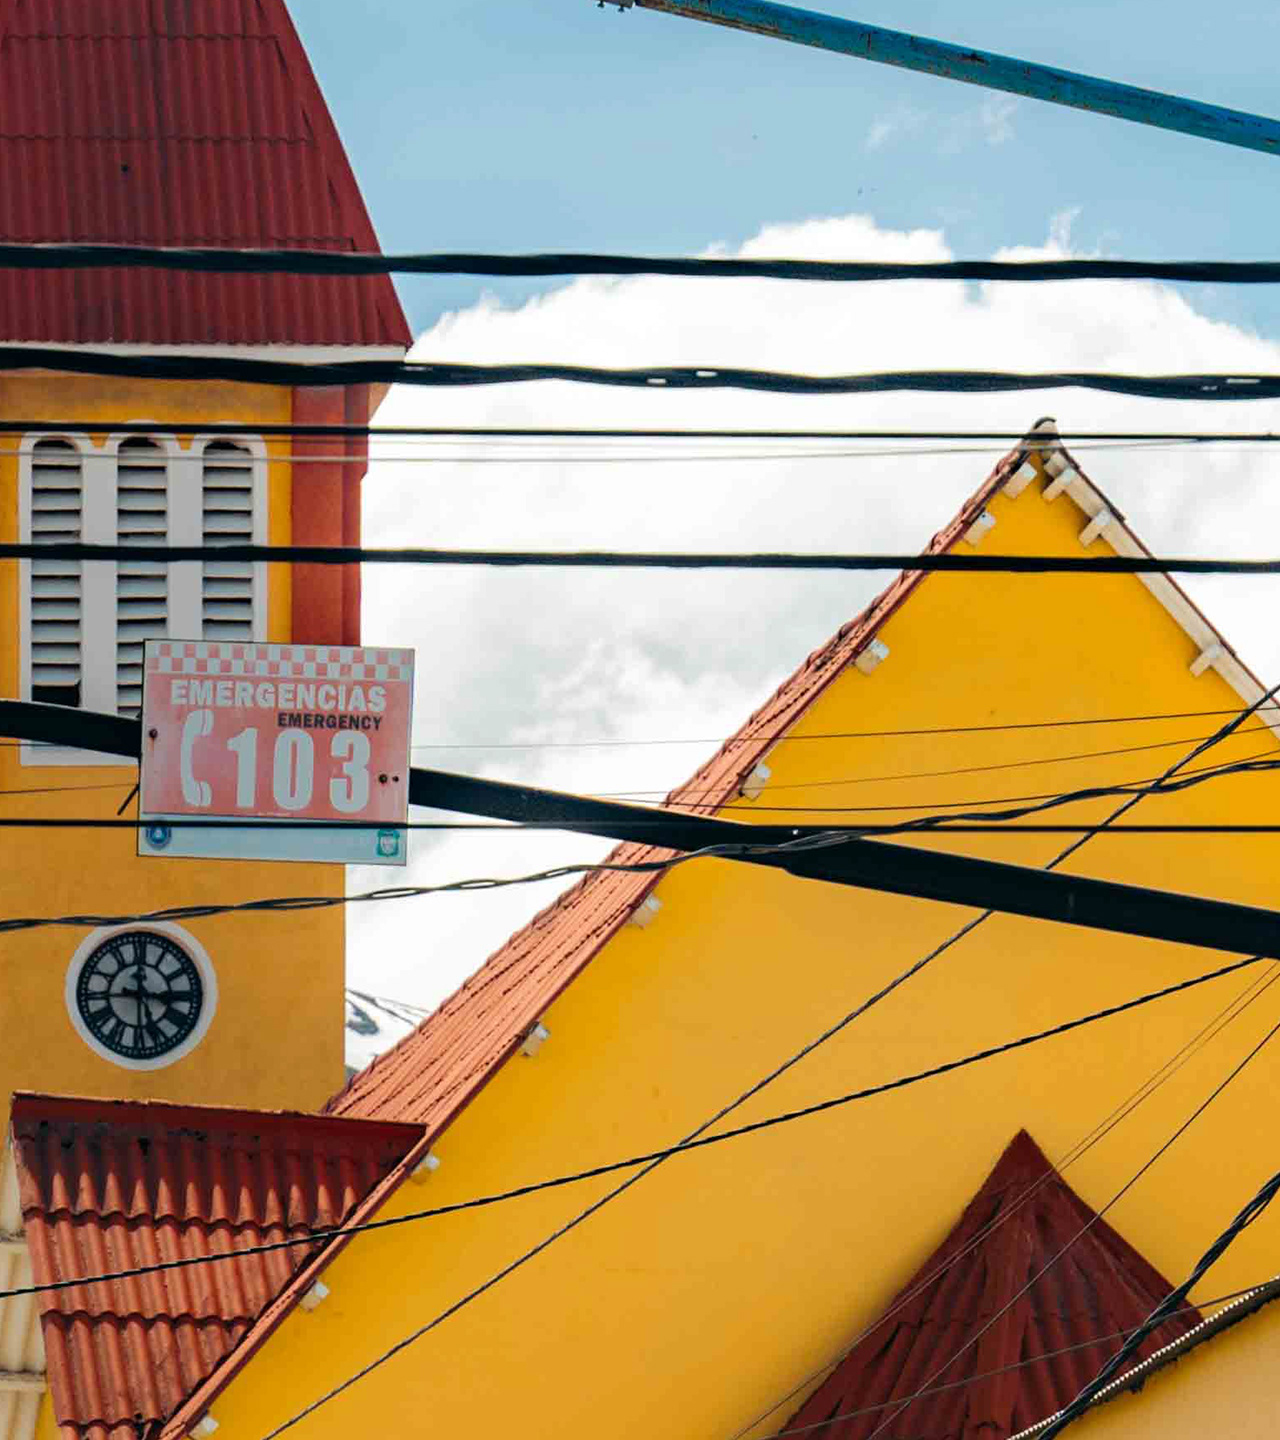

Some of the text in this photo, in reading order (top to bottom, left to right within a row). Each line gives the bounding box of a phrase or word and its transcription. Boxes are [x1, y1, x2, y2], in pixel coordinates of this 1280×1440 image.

[170, 679, 387, 712] EMERGENCIAS
[277, 712, 383, 731] EMERGENCY
[226, 727, 371, 814] 103
